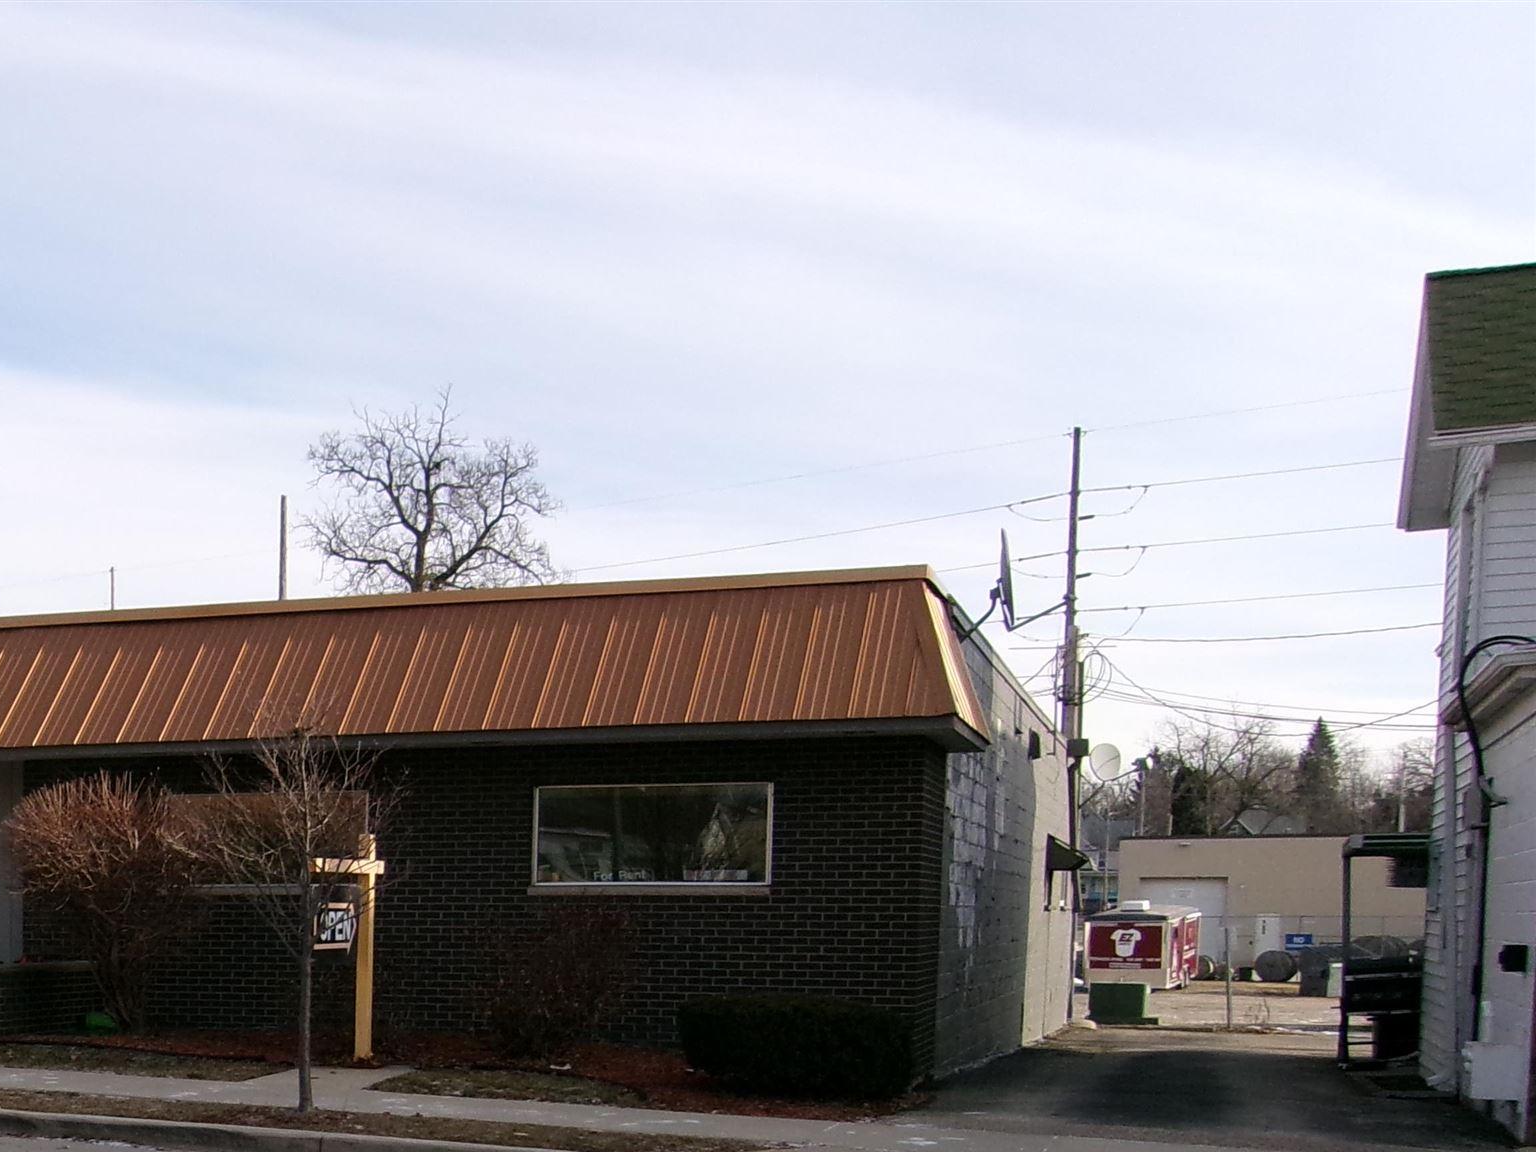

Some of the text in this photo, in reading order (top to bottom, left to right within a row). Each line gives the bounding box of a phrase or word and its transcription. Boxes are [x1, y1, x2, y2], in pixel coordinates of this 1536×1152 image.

[593, 869, 646, 881] For Rent
[320, 911, 351, 941] OPEN
